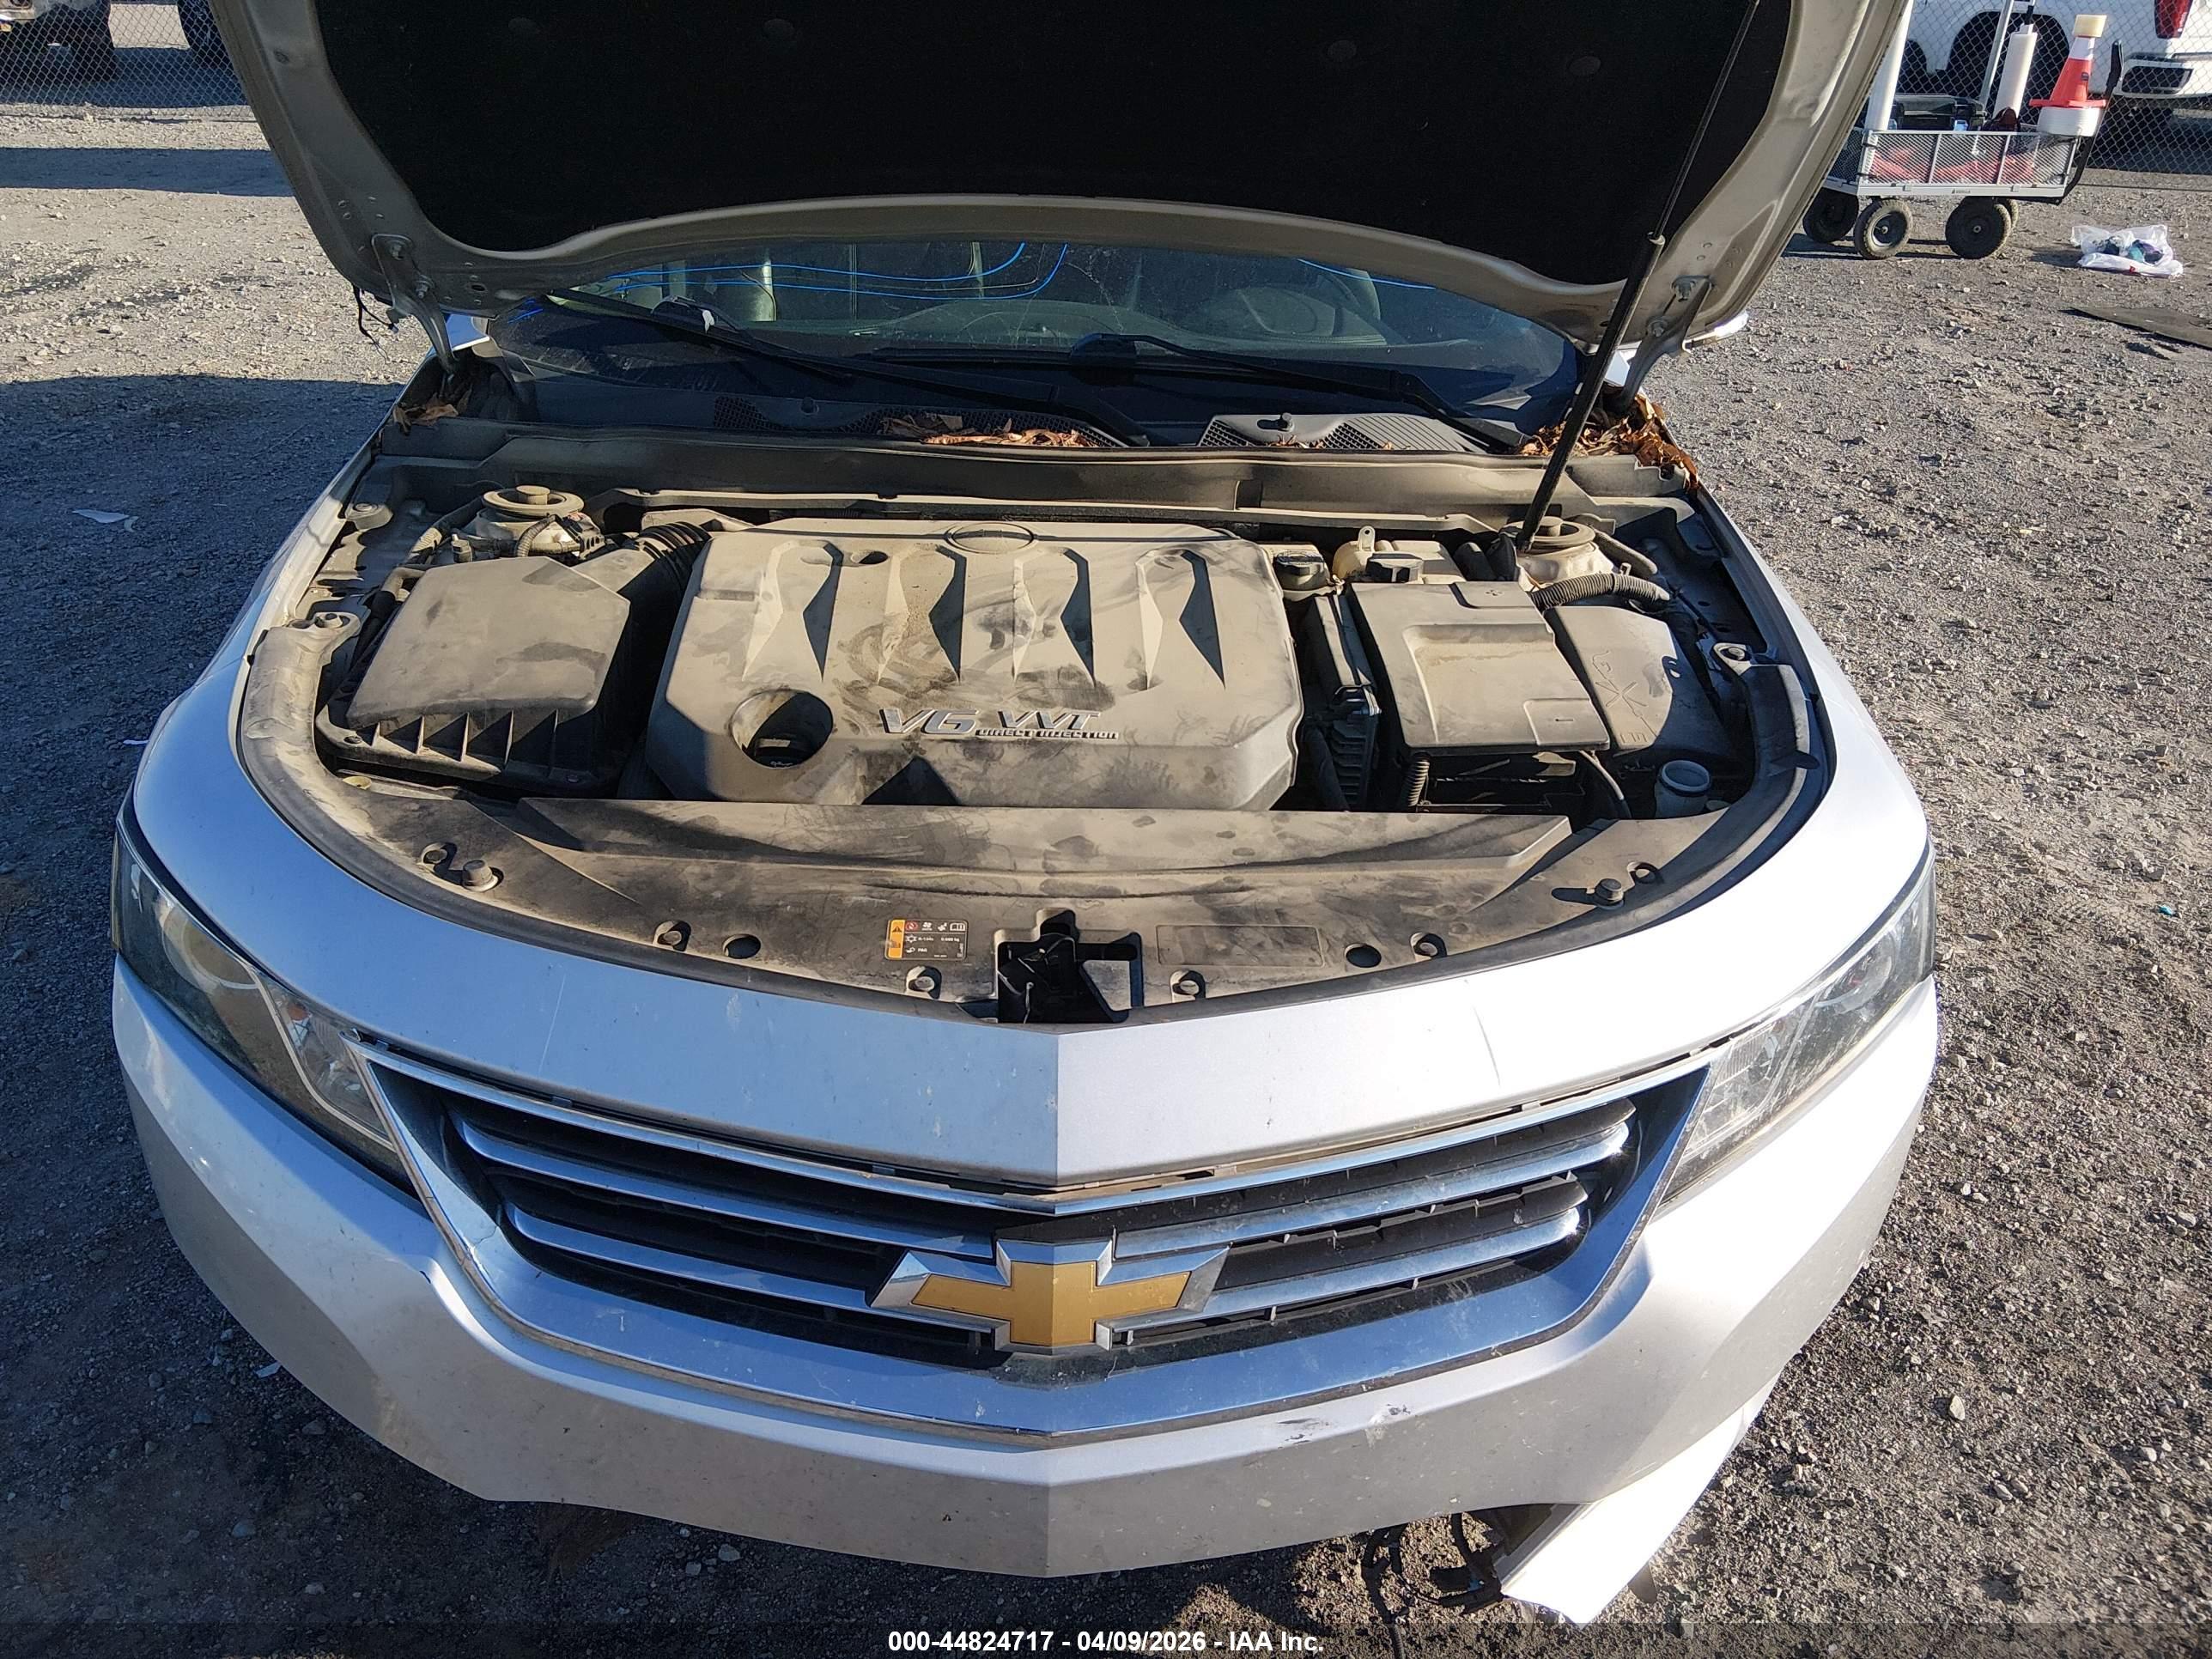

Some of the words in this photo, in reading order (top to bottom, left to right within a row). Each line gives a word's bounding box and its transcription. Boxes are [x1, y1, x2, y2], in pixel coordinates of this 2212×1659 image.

[878, 708, 979, 735] V6
[997, 709, 1102, 731] VVT
[975, 728, 1032, 738] DIRECT
[1035, 729, 1119, 739] INJECTION
